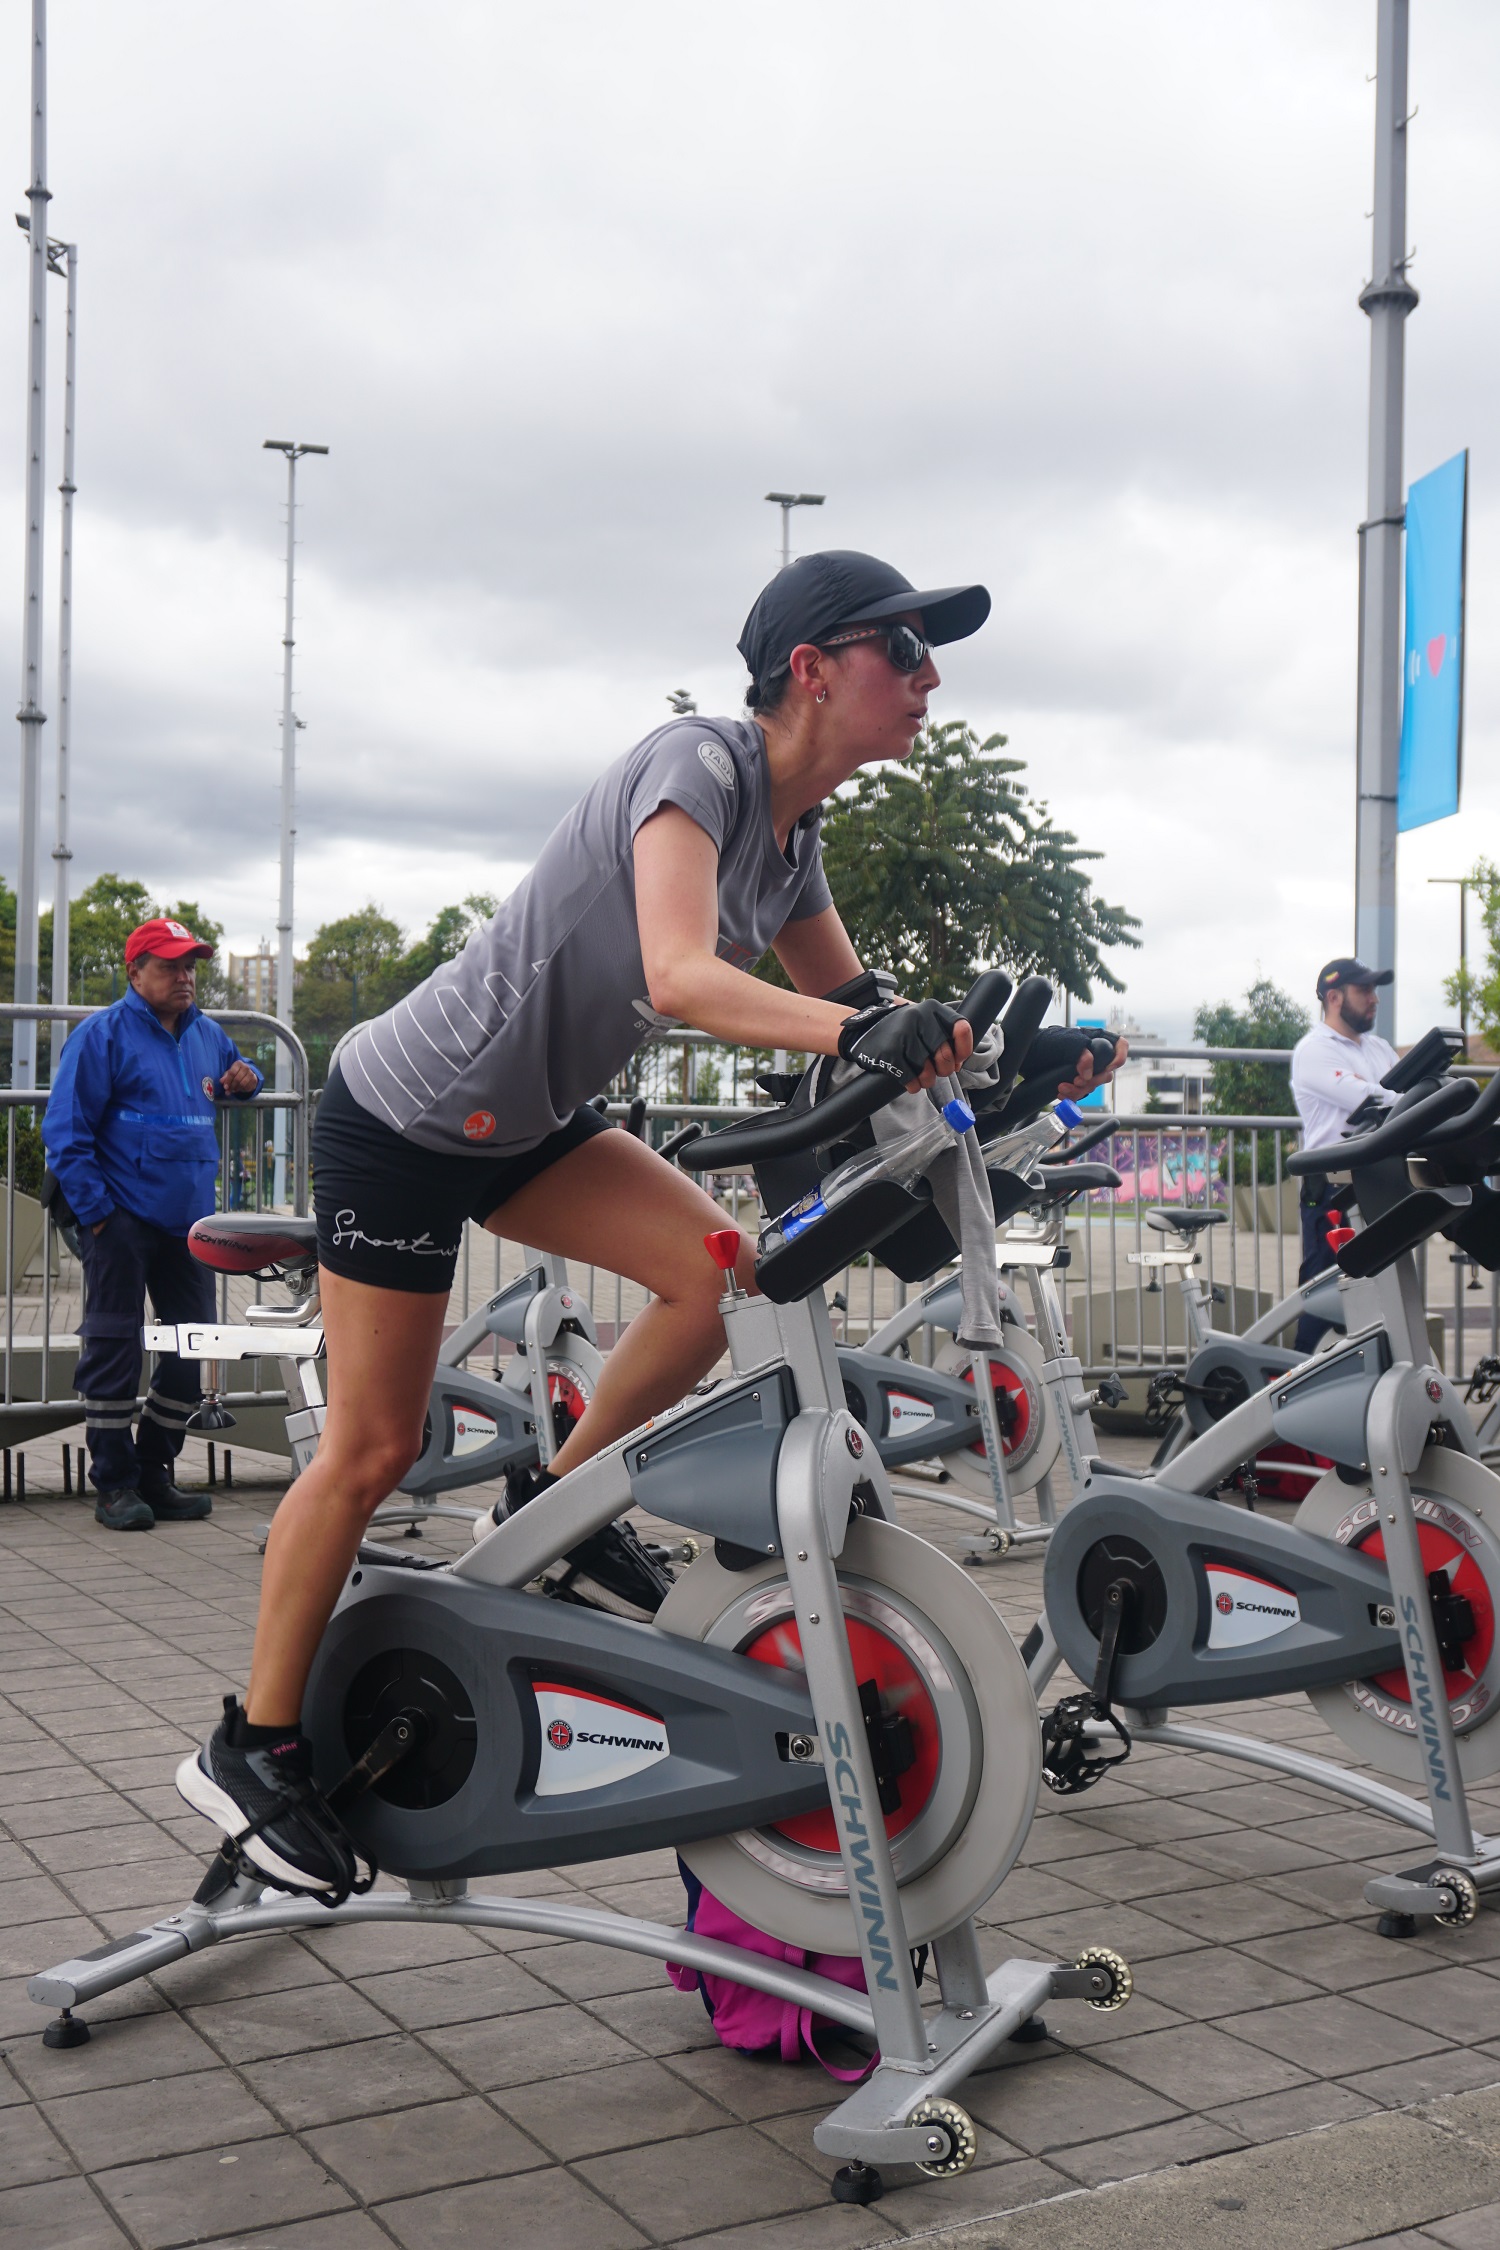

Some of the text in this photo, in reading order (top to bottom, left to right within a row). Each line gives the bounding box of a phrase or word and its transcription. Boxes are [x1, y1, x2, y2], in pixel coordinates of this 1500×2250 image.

[193, 1231, 254, 1253] SCHWINN
[902, 1410, 933, 1418] SCHWINN
[466, 1426, 496, 1435] SCHWINN
[981, 1400, 1004, 1503] SCHWINN
[1236, 1602, 1296, 1618] SCHWINN
[1400, 1593, 1451, 1802] SCHWINN
[576, 1732, 664, 1752] SCHWINN
[825, 1719, 900, 1994] SCHWINN
